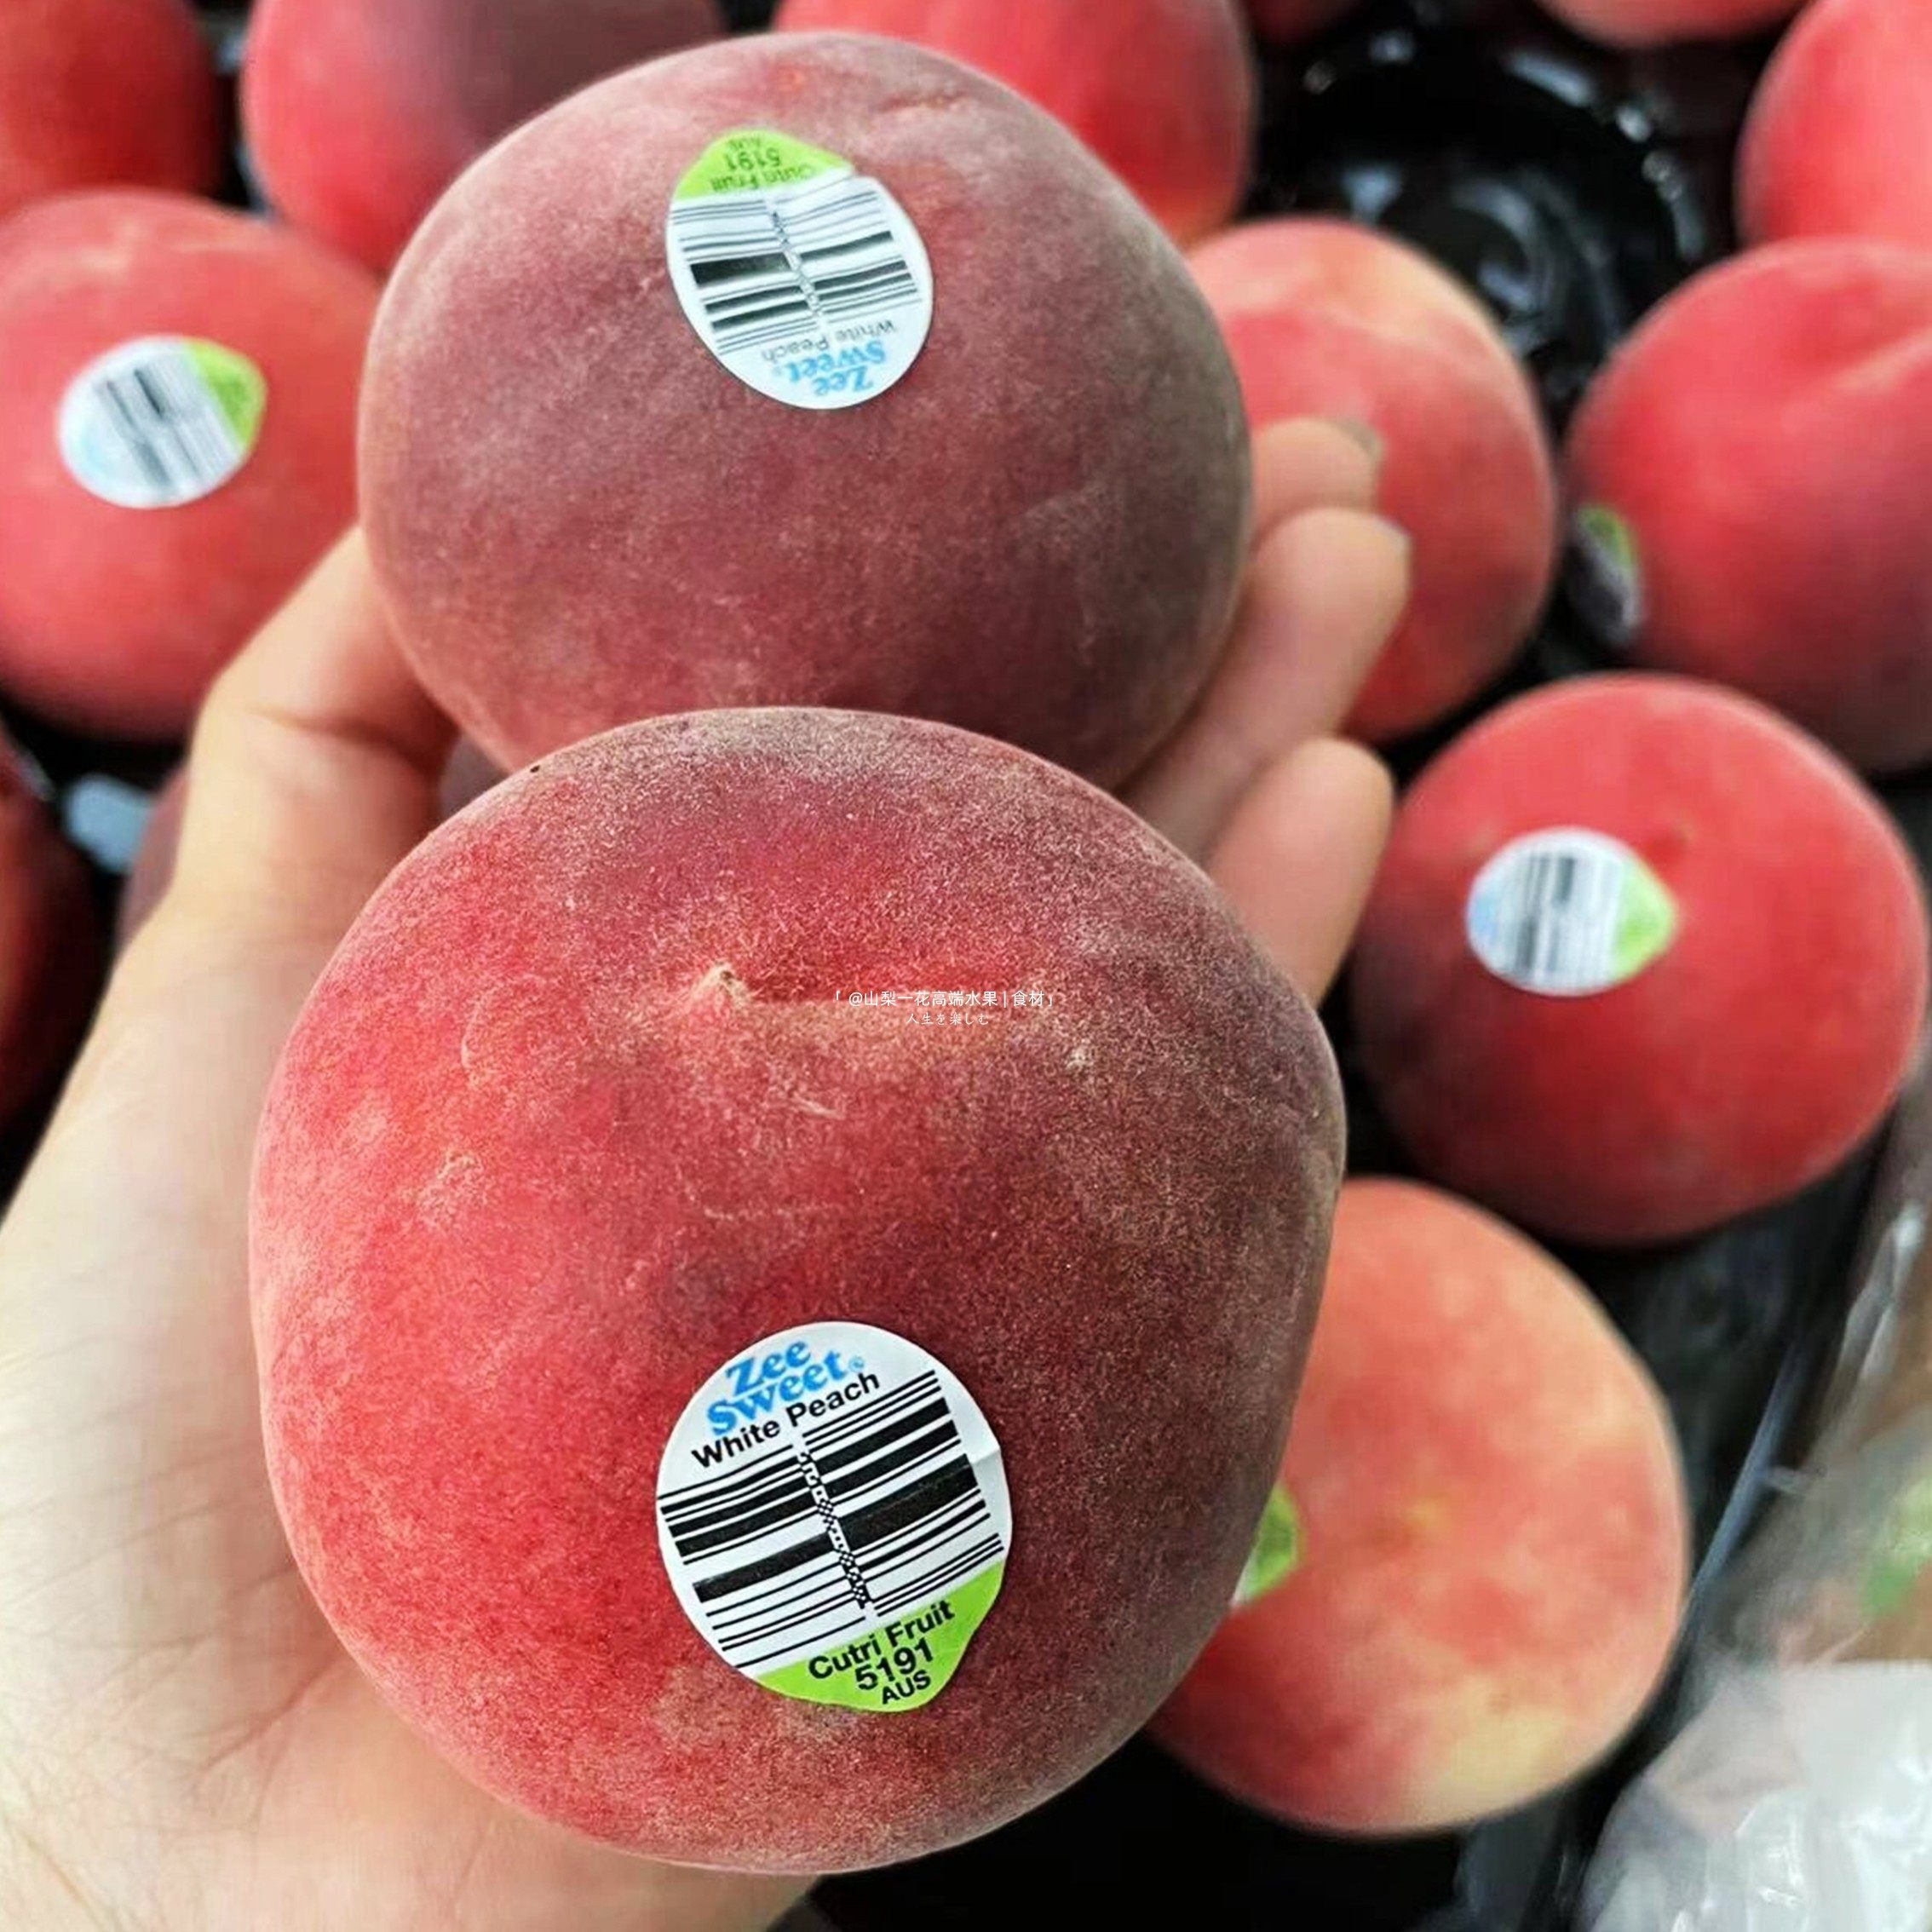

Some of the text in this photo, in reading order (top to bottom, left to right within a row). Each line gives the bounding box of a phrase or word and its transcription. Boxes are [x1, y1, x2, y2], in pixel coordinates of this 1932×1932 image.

[723, 147, 782, 171] 5191
[762, 336, 830, 365] Peach
[813, 365, 874, 397] Zee
[726, 1340, 812, 1397] Zee
[691, 1371, 881, 1469] White Peach
[808, 1599, 956, 1680] Cutri Fruit
[854, 1636, 934, 1691] 5191
[882, 1669, 932, 1705] AUS
